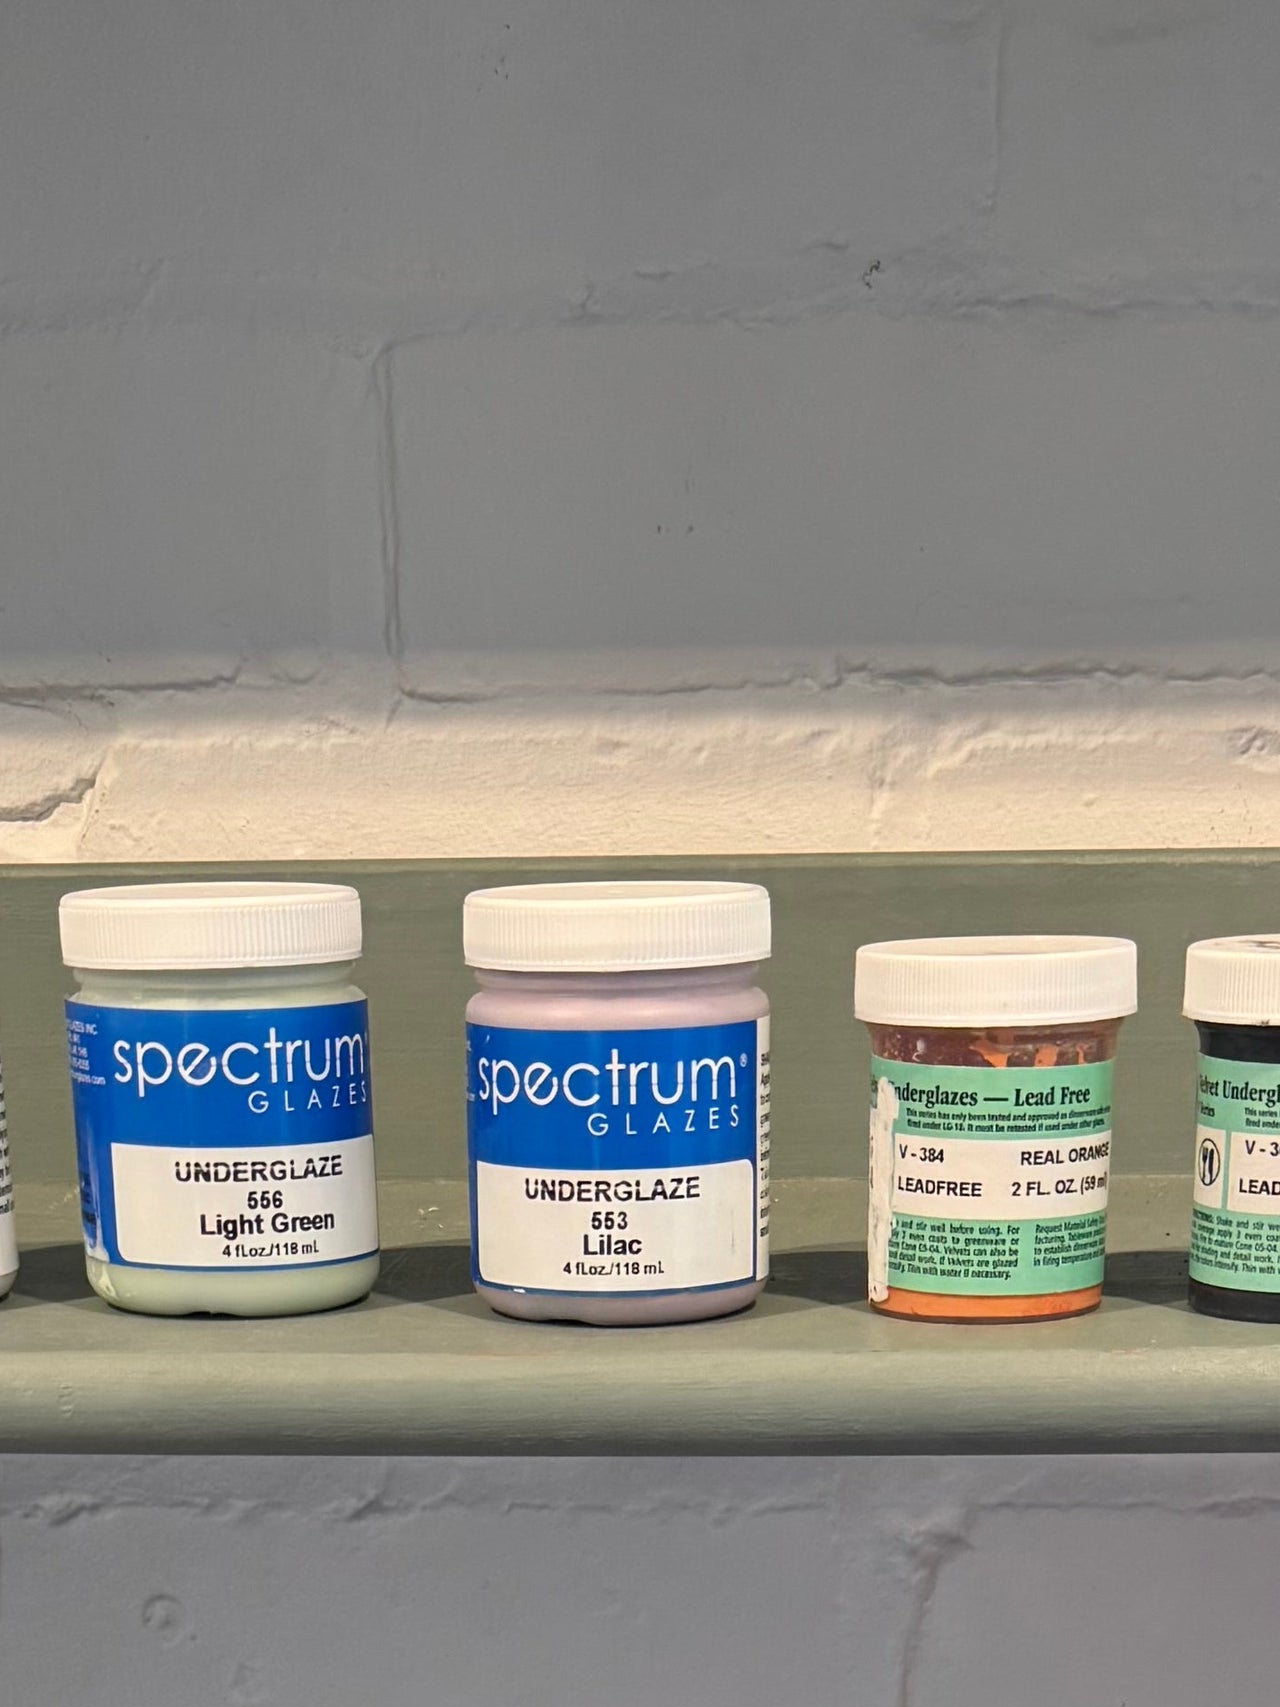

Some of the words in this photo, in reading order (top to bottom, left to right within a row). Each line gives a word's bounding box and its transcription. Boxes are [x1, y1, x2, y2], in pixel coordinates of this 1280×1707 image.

[113, 1027, 364, 1097] spectrum
[478, 1049, 736, 1115] spectrum
[248, 1080, 367, 1114] GLAZES
[1014, 1086, 1056, 1107] Lead
[1061, 1086, 1091, 1104] Free
[587, 1104, 739, 1136] GLAZES
[899, 1144, 908, 1159] V
[920, 1147, 944, 1163] 384
[1020, 1150, 1064, 1166] REAL
[1068, 1141, 1109, 1163] ORANGE
[1245, 1140, 1256, 1155] V
[175, 1154, 343, 1183] UNDERGLAZE
[525, 1176, 701, 1202] UNDERGLAZE
[898, 1175, 982, 1197] LEADFREE
[1012, 1182, 1021, 1196] 2
[247, 1190, 283, 1209] 556
[200, 1213, 264, 1240] Light
[271, 1212, 335, 1236] Green
[591, 1211, 628, 1230] 553
[222, 1245, 231, 1258] 4
[583, 1234, 642, 1256] Lilac
[563, 1262, 572, 1275] 4
